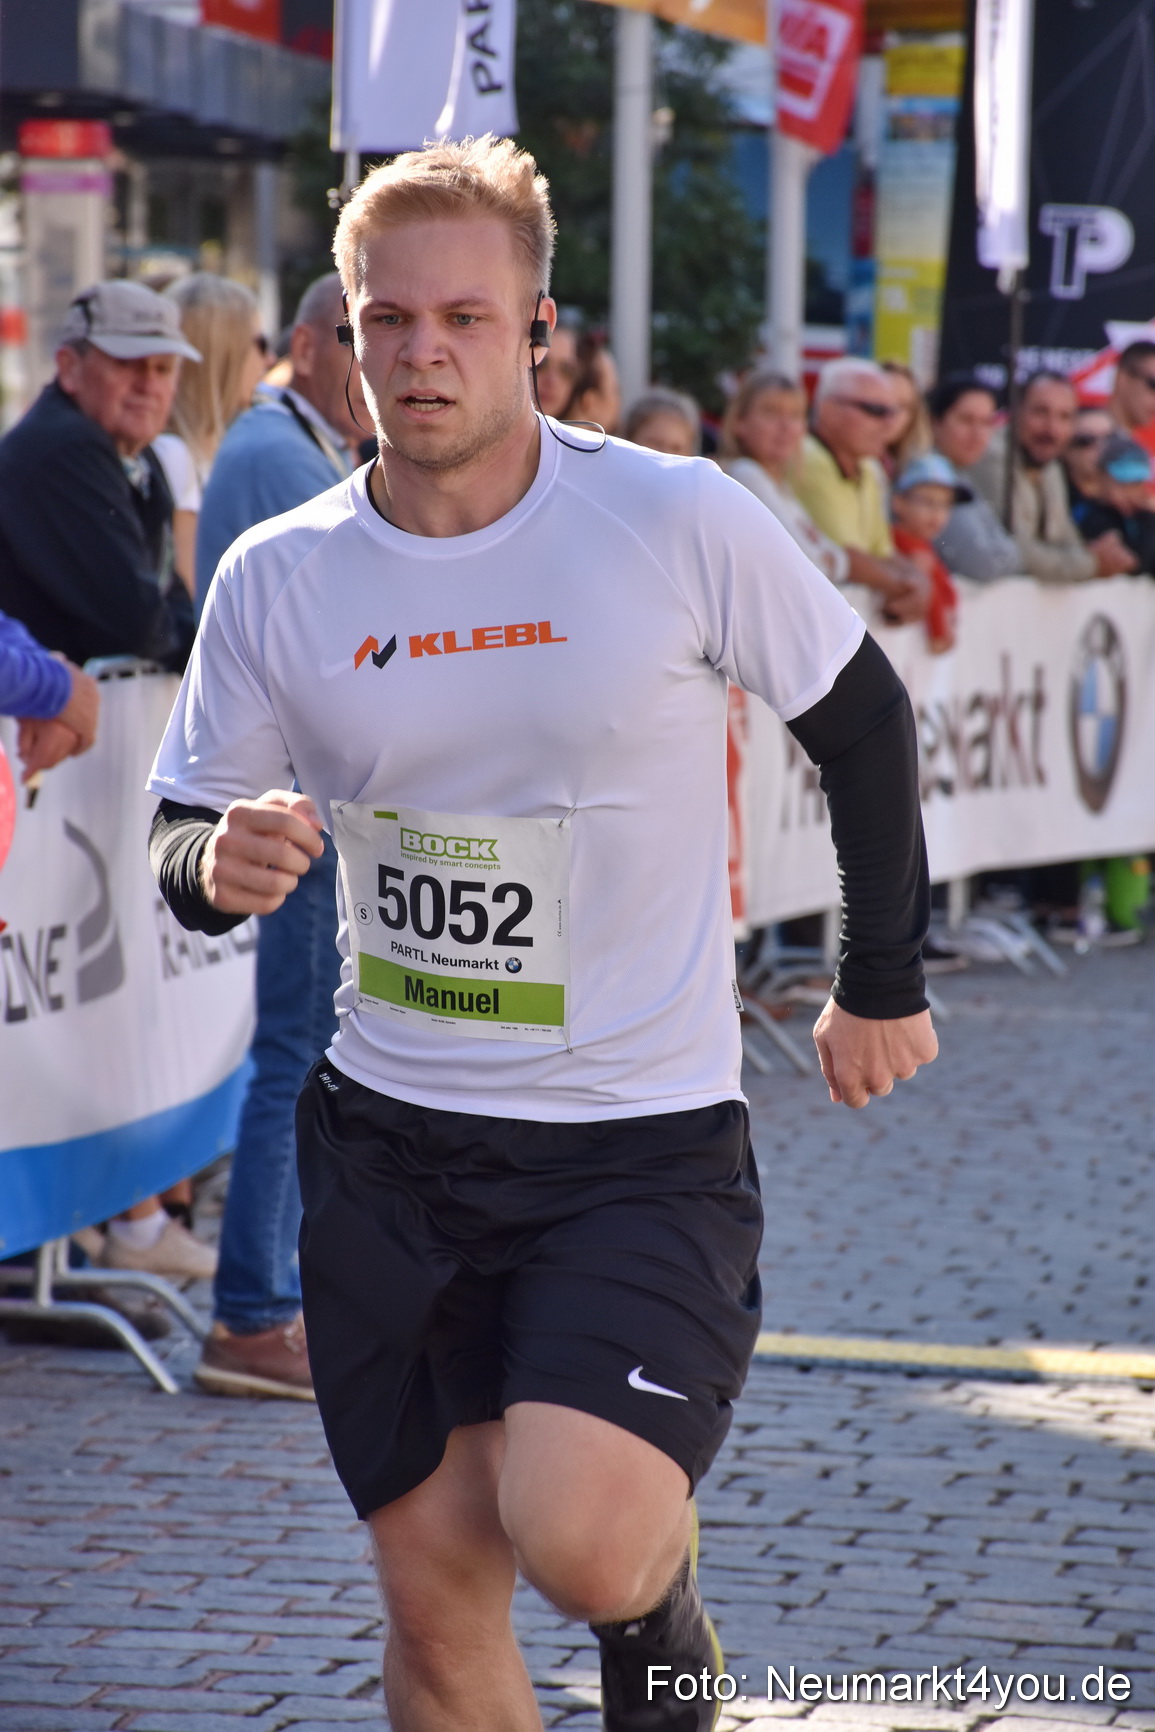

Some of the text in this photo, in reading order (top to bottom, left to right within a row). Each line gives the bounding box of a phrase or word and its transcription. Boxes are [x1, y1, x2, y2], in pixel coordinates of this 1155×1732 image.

[408, 620, 568, 659] KLEBL
[400, 827, 500, 862] BOCK
[400, 851, 501, 871] inspired by smart concepts
[378, 863, 534, 948] 5052
[390, 941, 500, 971] PARTL Neumarkt
[404, 975, 500, 1015] Manuel
